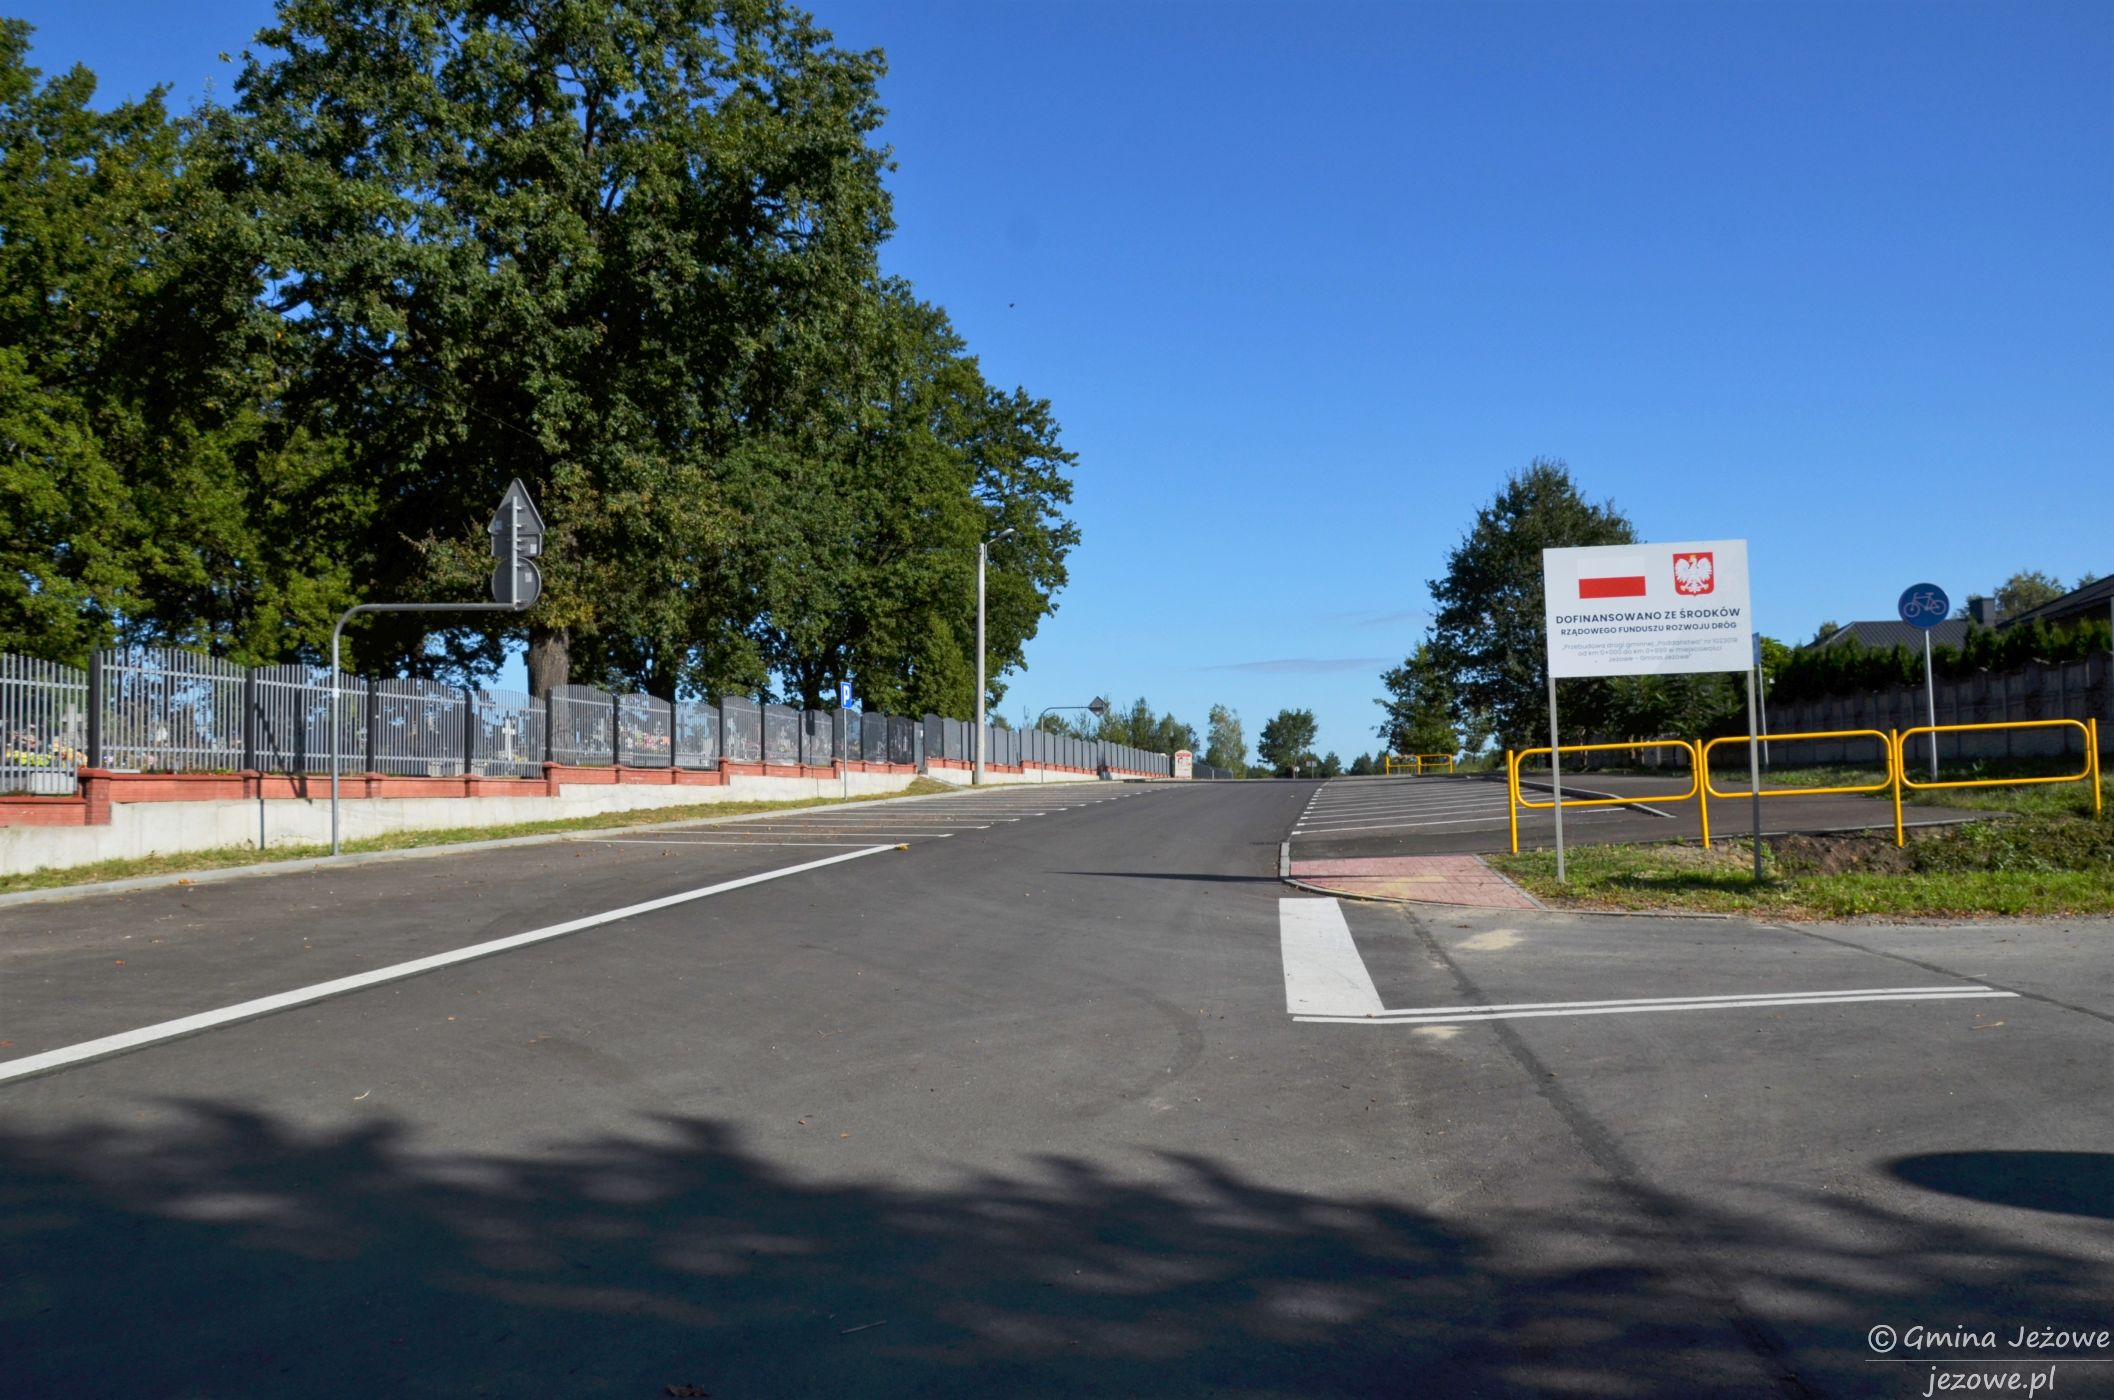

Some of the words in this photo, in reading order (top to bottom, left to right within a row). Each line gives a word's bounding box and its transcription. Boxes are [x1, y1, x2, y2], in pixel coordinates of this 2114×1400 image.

[1556, 611, 1662, 624] DOFINANSOWANO
[1664, 610, 1677, 620] ZE
[1679, 606, 1741, 619] ŚRODKÓW
[1560, 626, 1617, 636] RZĄDOWEGO
[1618, 624, 1664, 634] FUNDUSZU
[1665, 622, 1710, 632] ROZWOJU
[1711, 620, 1737, 630] DRÓG
[843, 685, 850, 706] P
